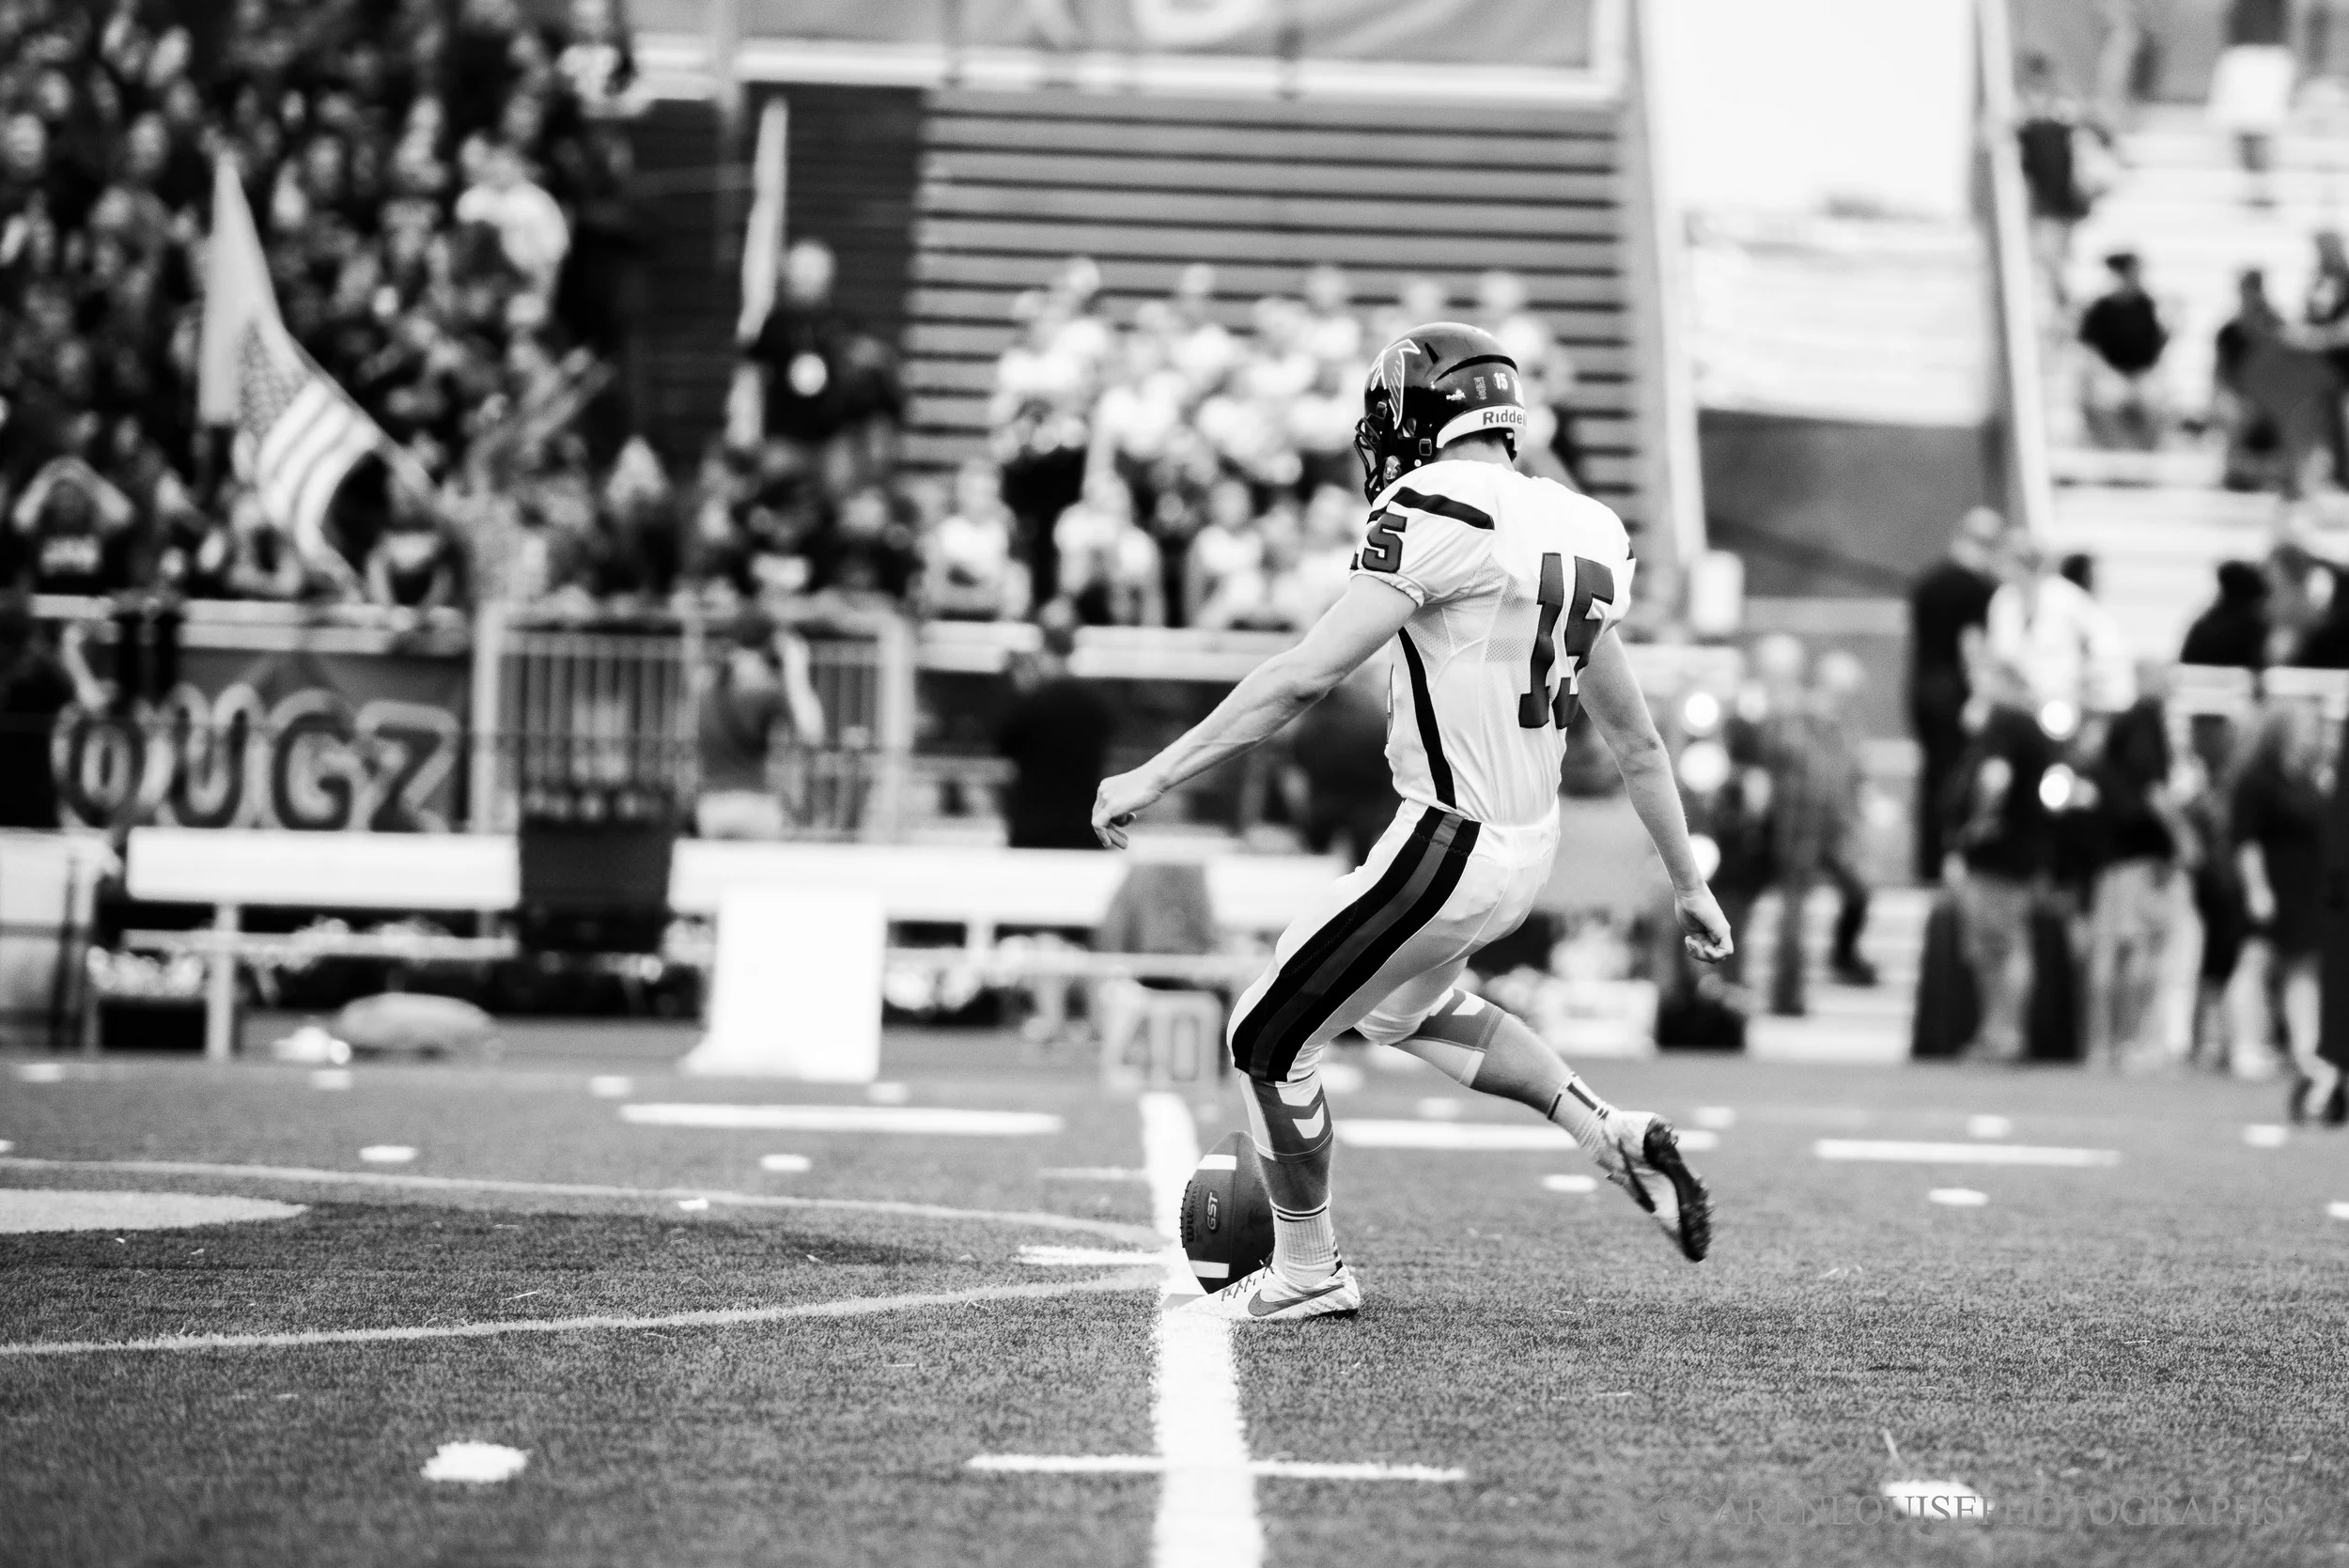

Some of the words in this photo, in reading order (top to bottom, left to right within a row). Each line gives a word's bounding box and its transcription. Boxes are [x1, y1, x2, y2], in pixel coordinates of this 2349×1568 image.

[1493, 372, 1508, 390] 15
[1518, 552, 1614, 730] 15
[1206, 1191, 1219, 1231] GST
